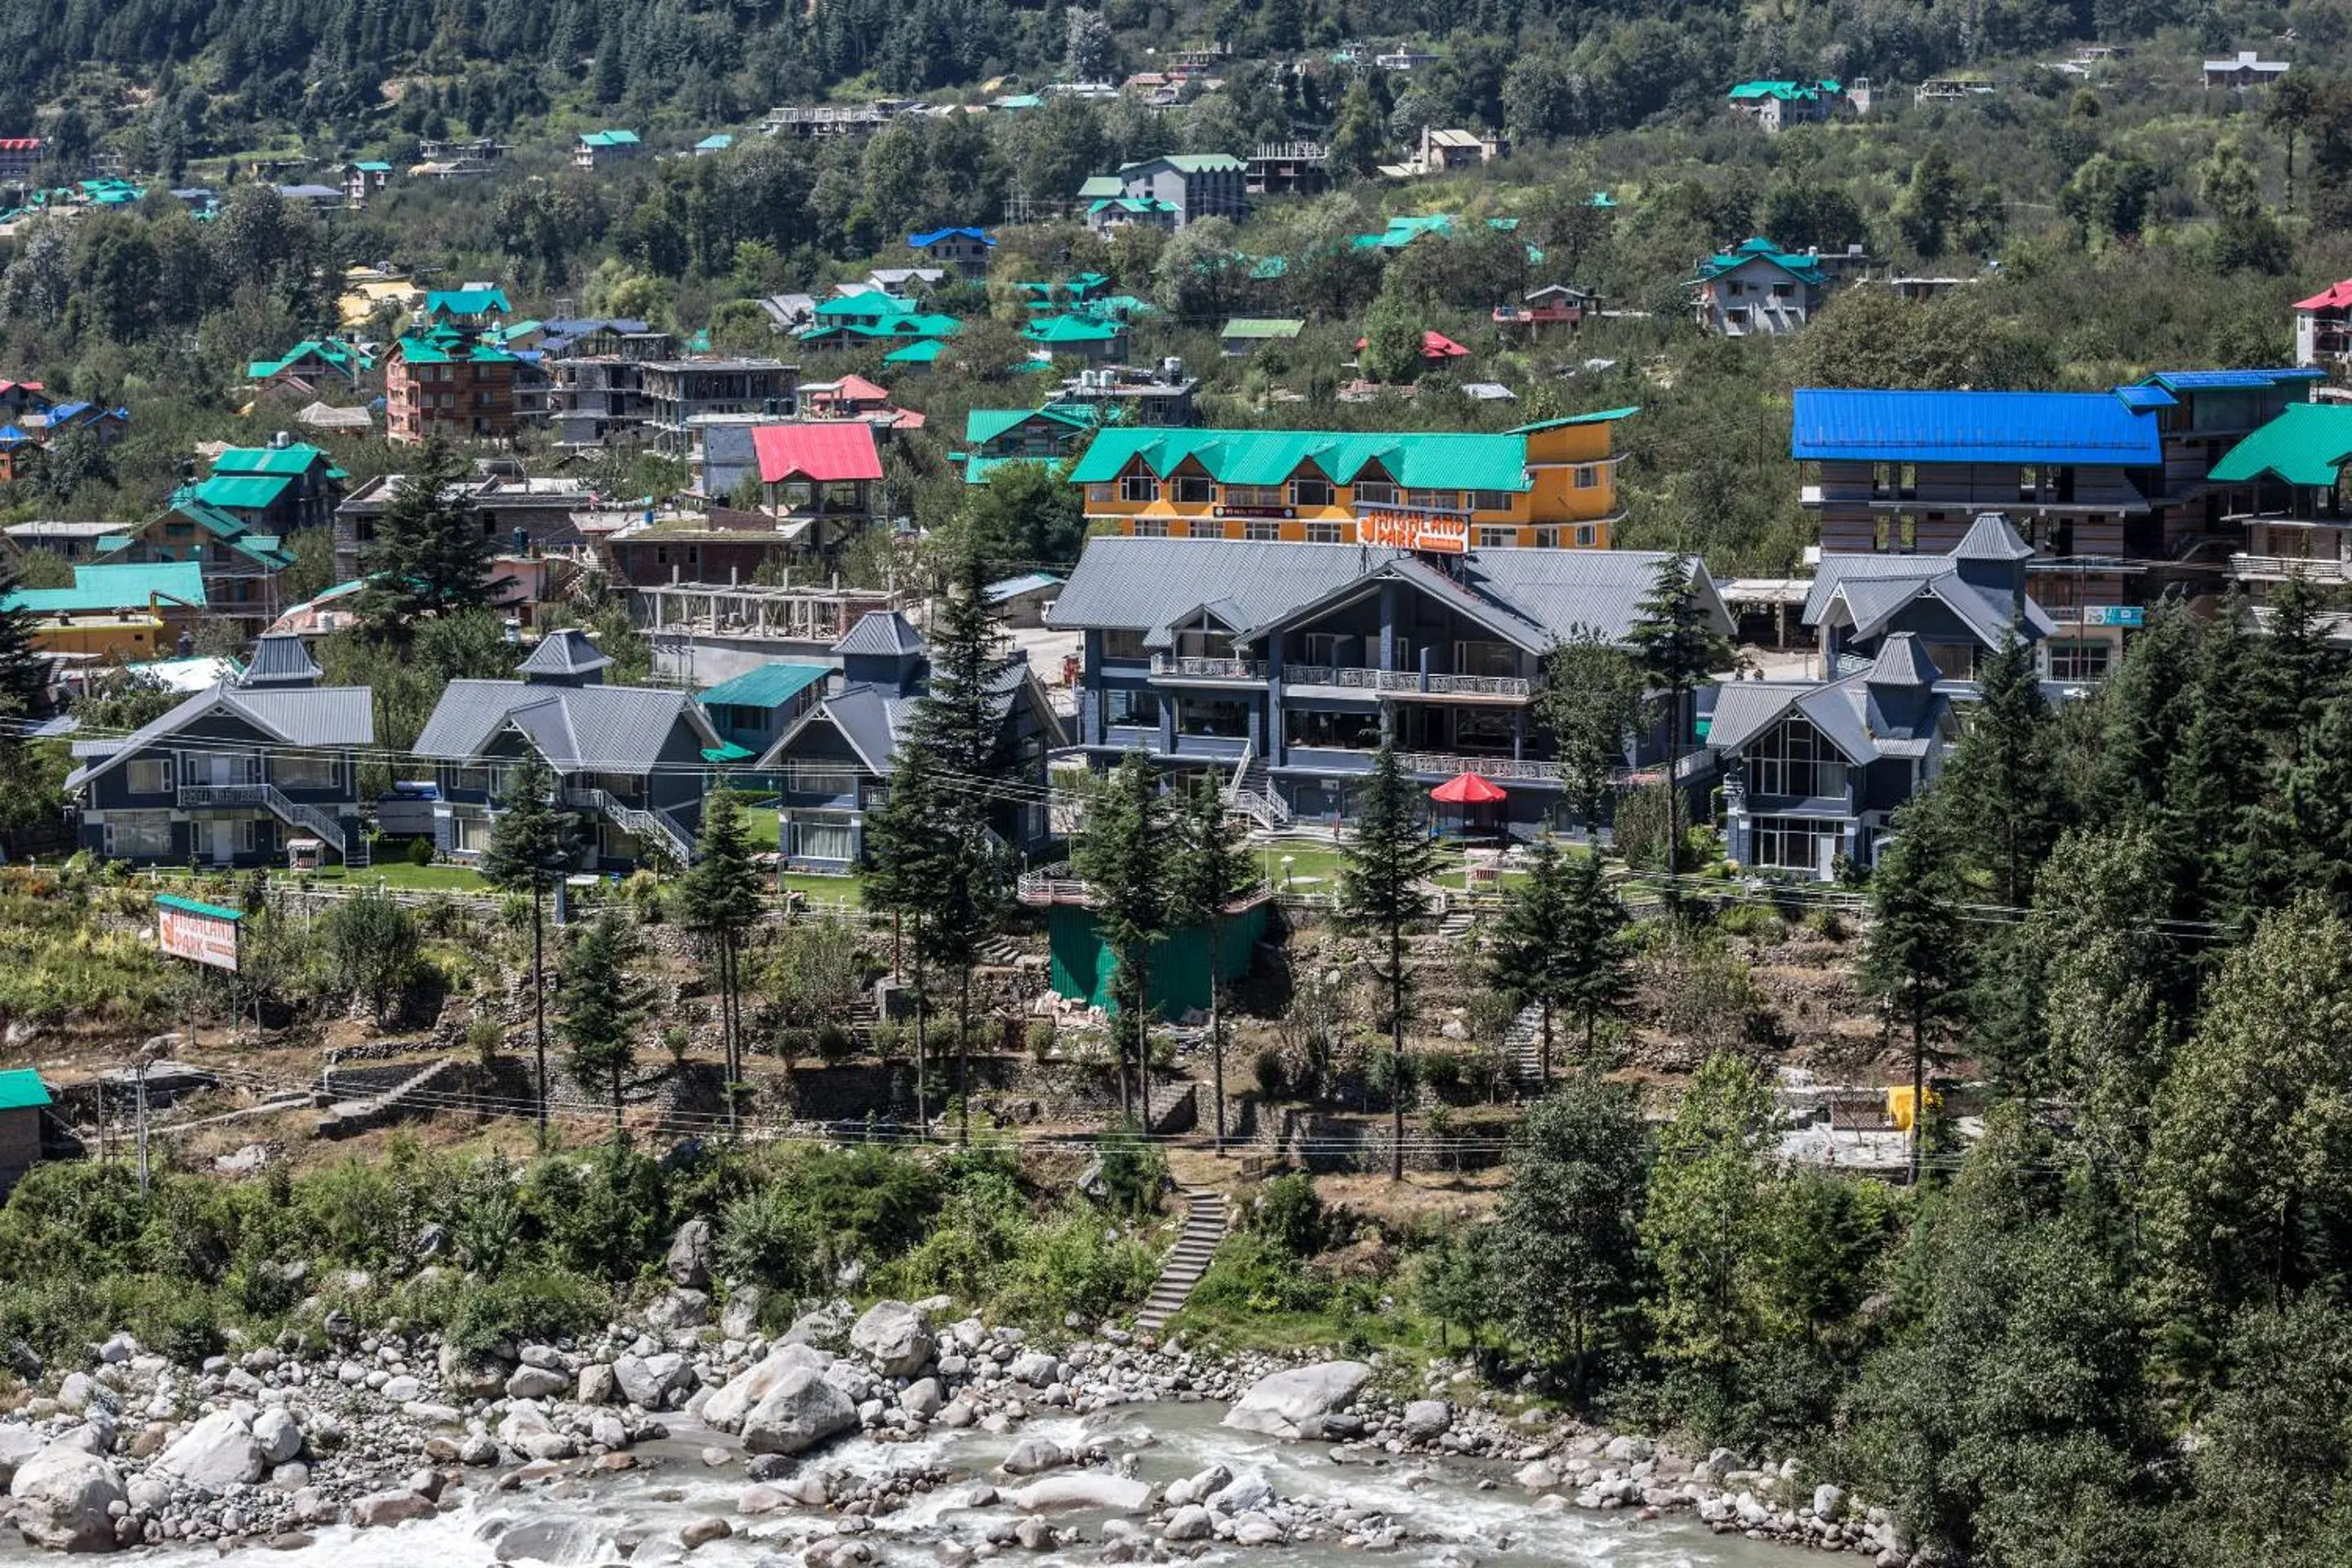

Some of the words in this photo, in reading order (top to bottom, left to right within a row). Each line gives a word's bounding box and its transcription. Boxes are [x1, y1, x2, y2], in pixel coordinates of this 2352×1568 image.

[1376, 510, 1464, 535] HIGHLAND
[1376, 529, 1417, 549] PARK
[175, 909, 232, 941] HIGHLAND
[175, 932, 204, 957] PARK
